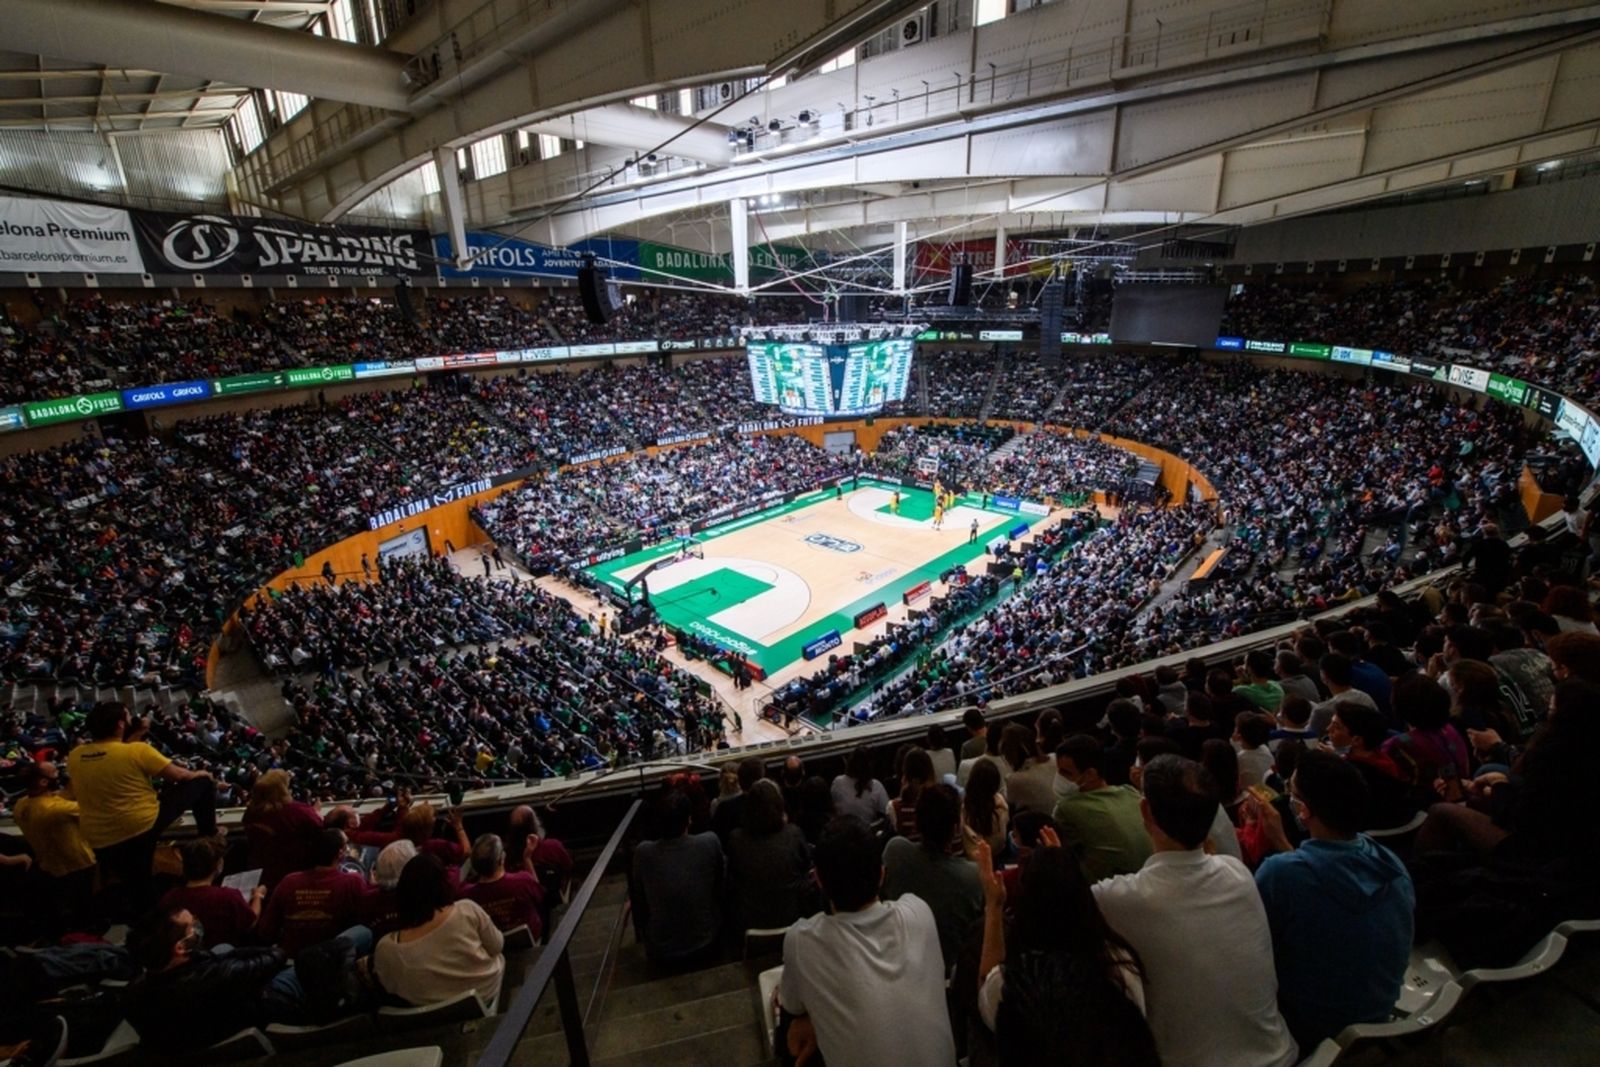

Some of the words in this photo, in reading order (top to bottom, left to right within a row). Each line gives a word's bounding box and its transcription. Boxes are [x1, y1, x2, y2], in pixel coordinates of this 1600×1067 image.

[47, 222, 131, 241] Premium
[253, 226, 418, 270] SPALDING
[469, 246, 536, 267] RIFOLS
[656, 251, 726, 269] BADALONA
[304, 266, 327, 274] TRUE
[330, 266, 340, 274] TO
[343, 267, 359, 275] THE
[360, 267, 383, 275] GAME
[132, 391, 166, 403] GRIFOLS
[172, 386, 203, 397] GRIFOLS
[29, 404, 77, 420] BADALONA
[94, 397, 119, 409] FUTUR
[369, 499, 431, 530] BADALONA
[456, 478, 493, 499] FUTUR
